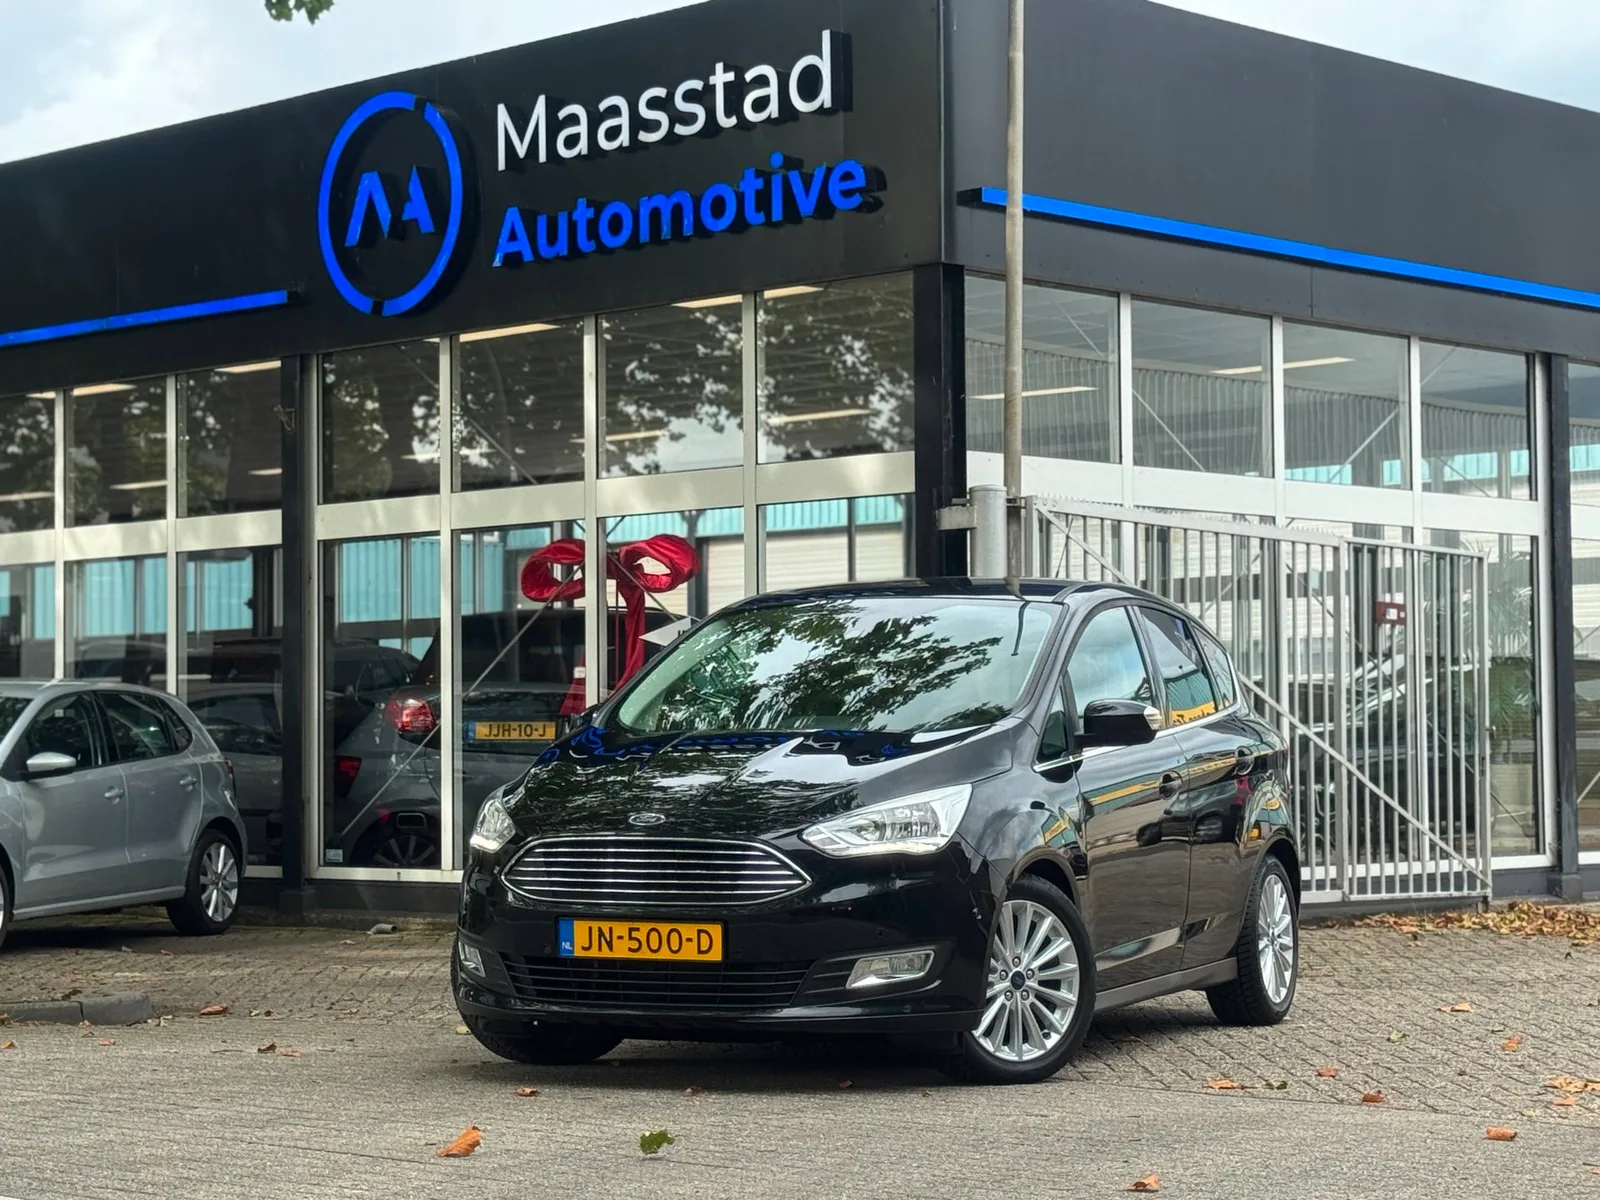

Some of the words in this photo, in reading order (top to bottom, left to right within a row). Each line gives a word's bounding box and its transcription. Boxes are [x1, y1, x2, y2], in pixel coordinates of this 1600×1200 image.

[497, 29, 833, 172] Maasstad
[492, 151, 868, 268] Automotive
[484, 723, 547, 738] JJH-10-J
[561, 941, 573, 950] NL
[581, 925, 714, 955] JN-500-D
